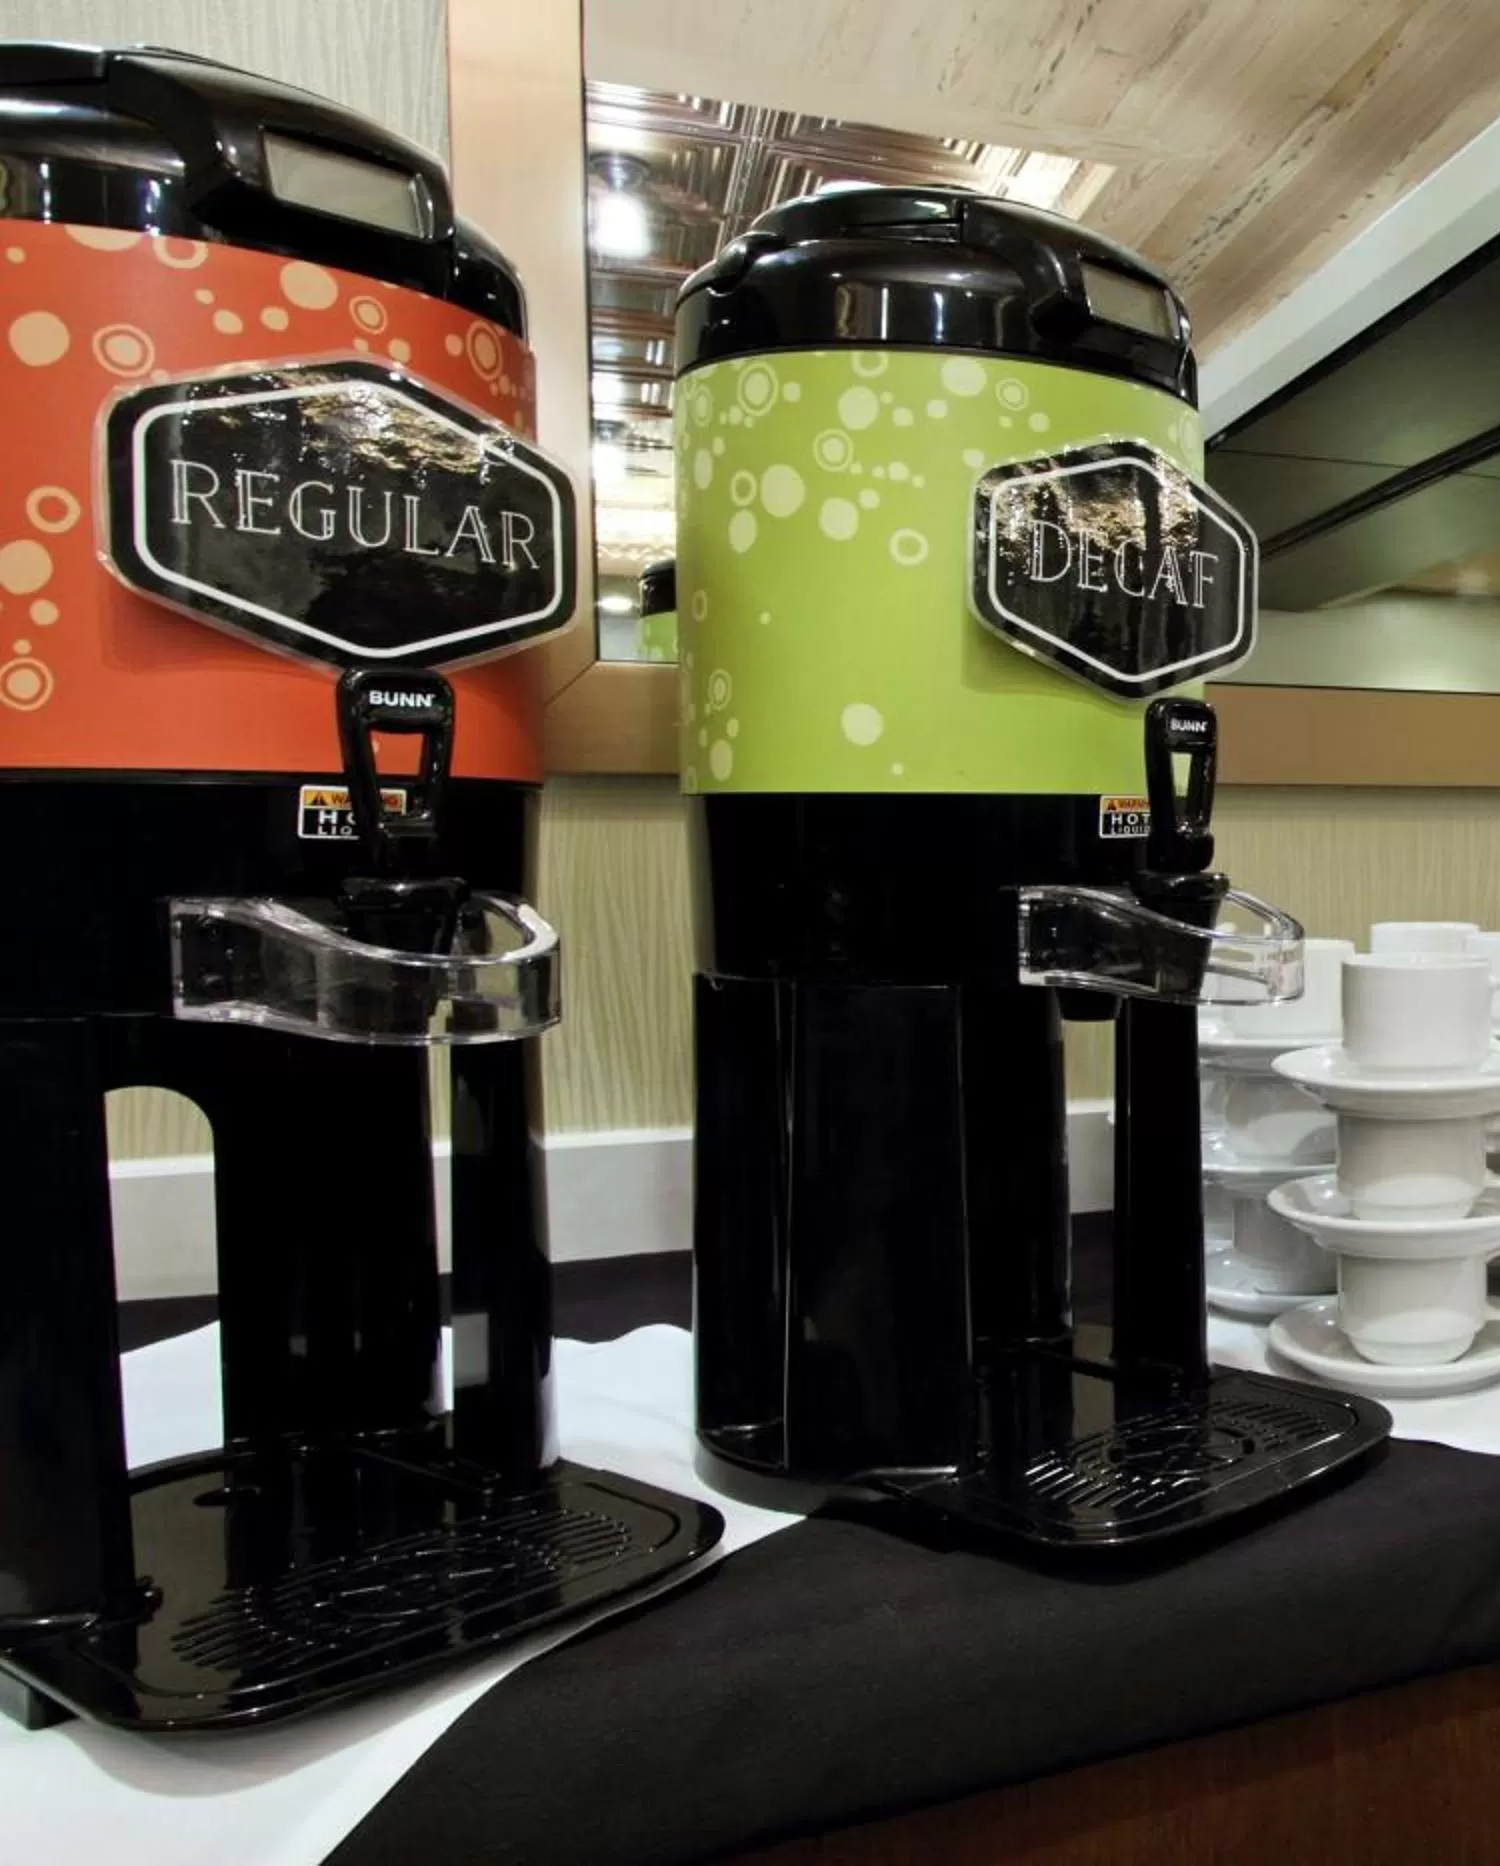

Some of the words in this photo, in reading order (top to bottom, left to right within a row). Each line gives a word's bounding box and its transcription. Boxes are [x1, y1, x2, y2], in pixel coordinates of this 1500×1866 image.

[169, 459, 540, 569] REGULAR
[1030, 520, 1219, 609] DECAF
[369, 690, 433, 707] BUNN
[1111, 813, 1151, 825] HOT
